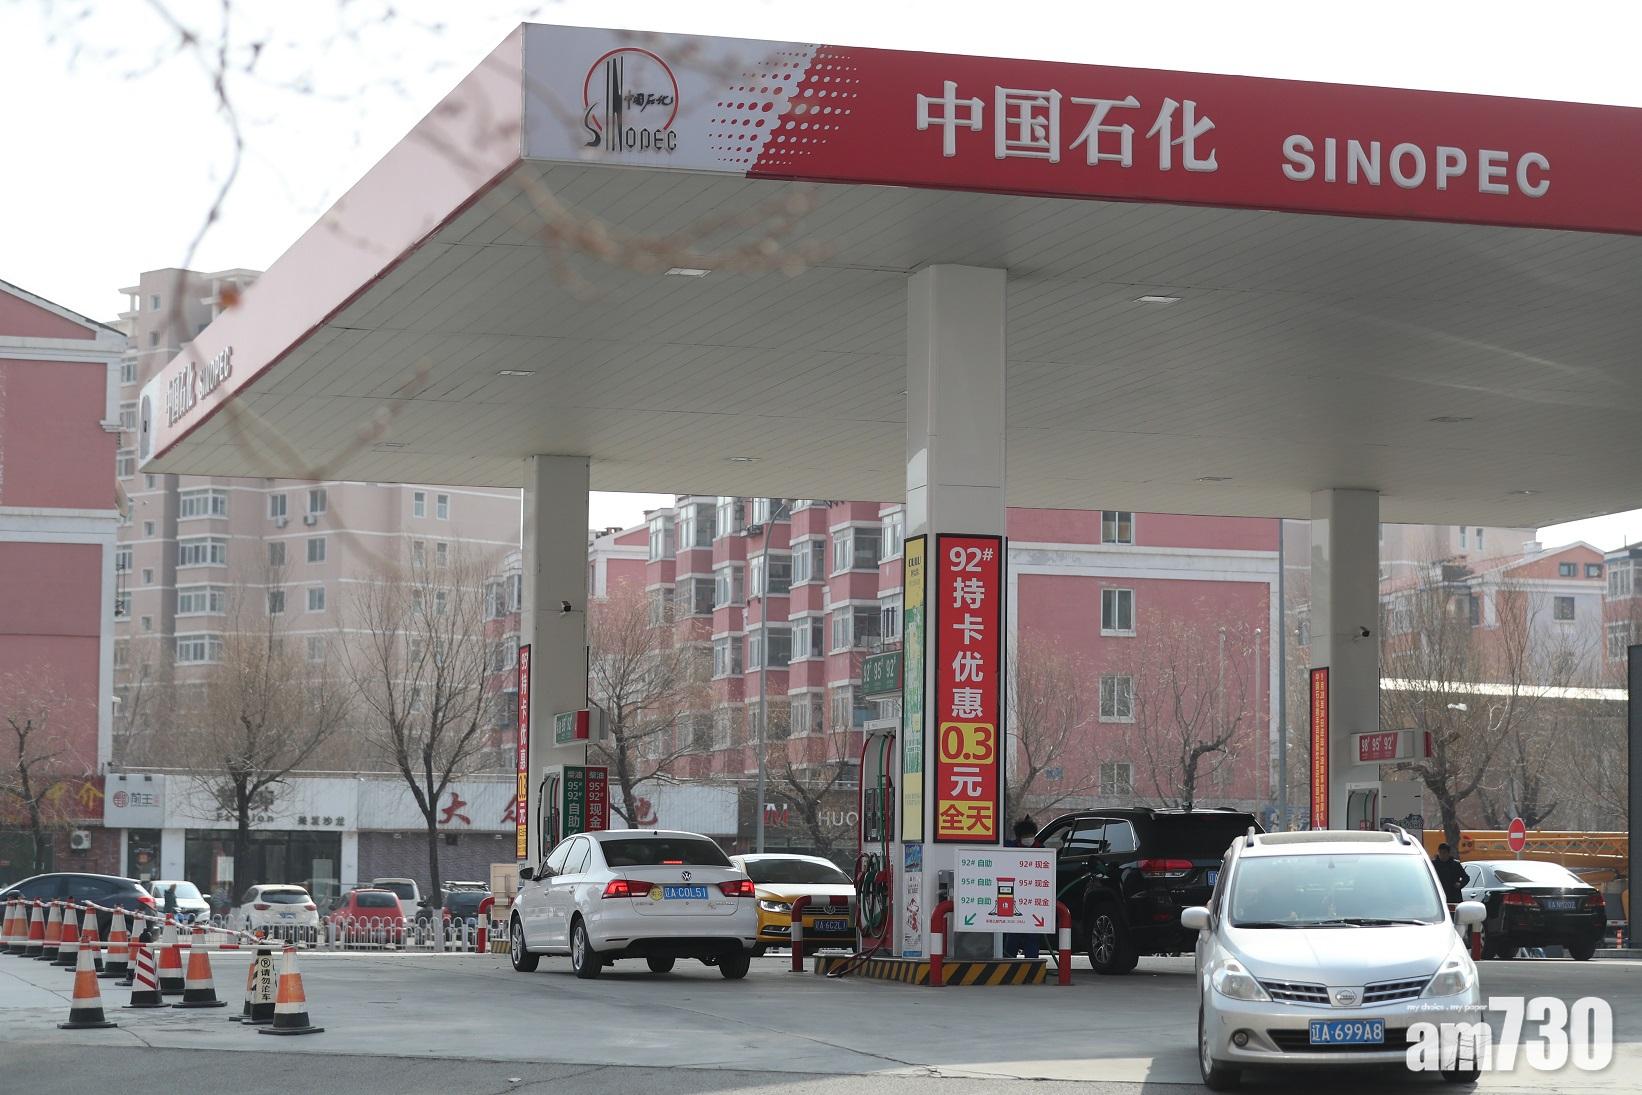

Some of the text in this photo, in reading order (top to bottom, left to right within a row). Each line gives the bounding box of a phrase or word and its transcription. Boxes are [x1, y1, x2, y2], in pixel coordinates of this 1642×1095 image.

[916, 80, 1218, 172] 中国石化
[1282, 134, 1551, 198] SINOPEC
[200, 346, 232, 400] SINOPEC
[949, 546, 993, 572] 92#
[952, 577, 986, 719] 持卡优惠
[941, 725, 993, 761] 0.3
[950, 766, 982, 797] 元
[940, 803, 991, 832] 全天
[977, 859, 993, 867] 自助
[1019, 860, 1050, 869] 92# 现金
[977, 878, 992, 886] 自助
[1019, 879, 1050, 888] 95# 现金
[961, 896, 992, 905] 92# 自助
[1034, 898, 1049, 907] 现金
